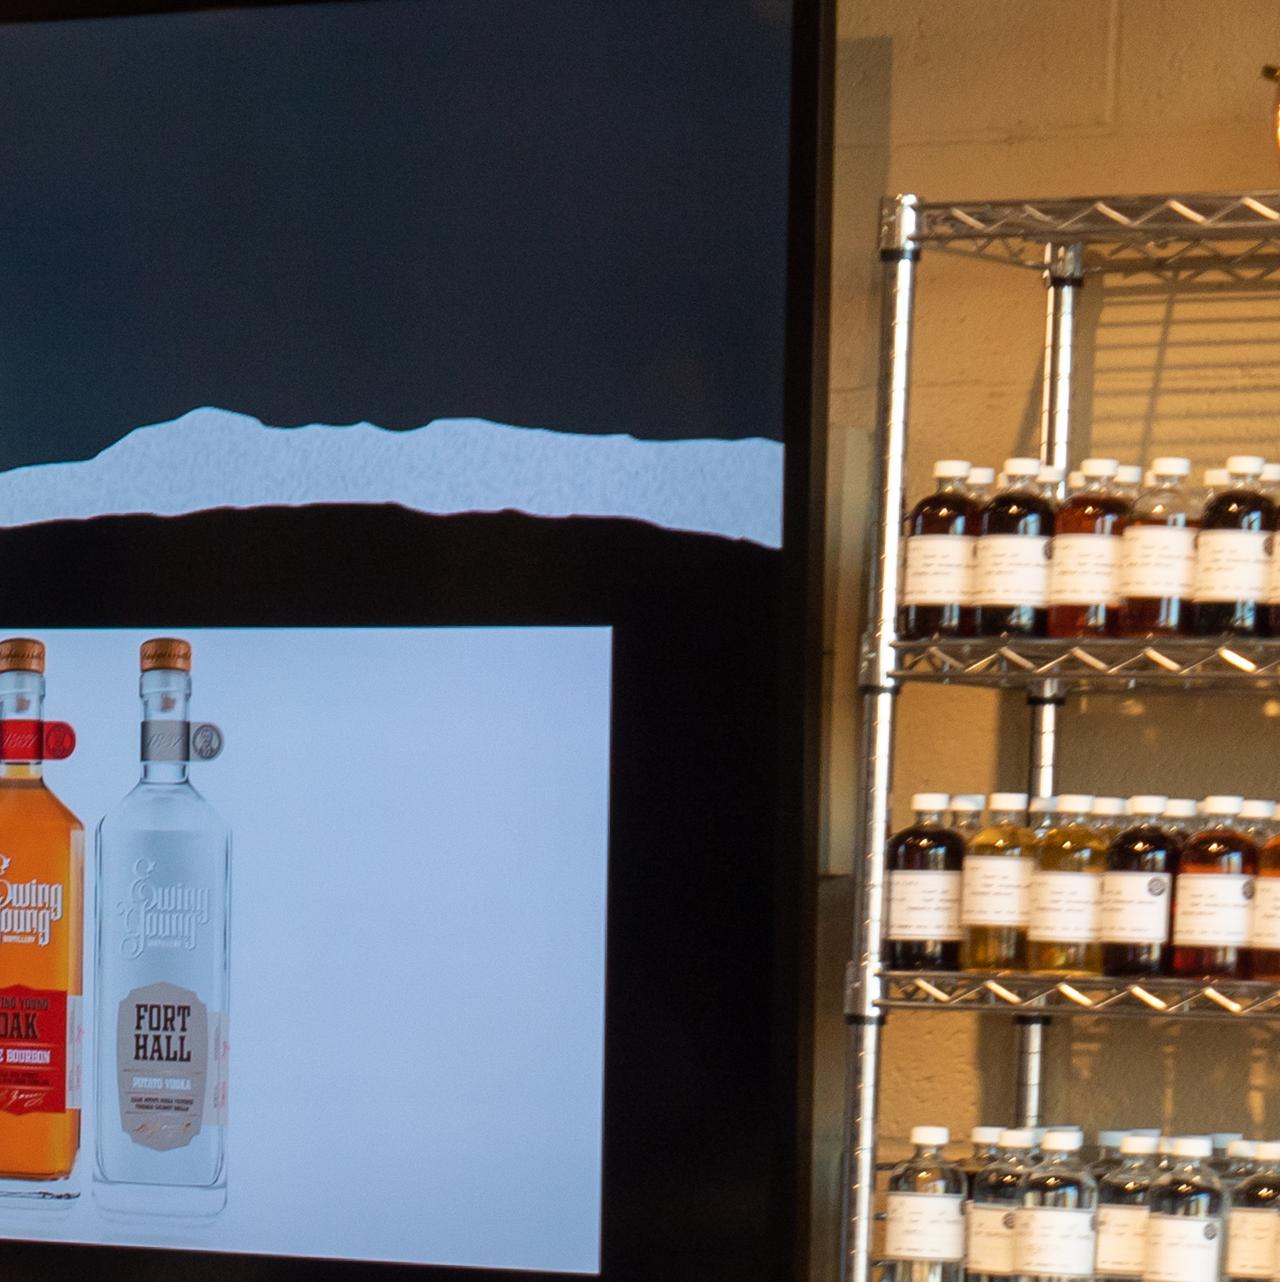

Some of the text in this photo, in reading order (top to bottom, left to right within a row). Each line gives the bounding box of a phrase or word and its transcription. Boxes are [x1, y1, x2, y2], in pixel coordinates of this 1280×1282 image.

[134, 1003, 192, 1033] FORT
[6, 1049, 51, 1065] BOURBON
[133, 1033, 192, 1063] HALL
